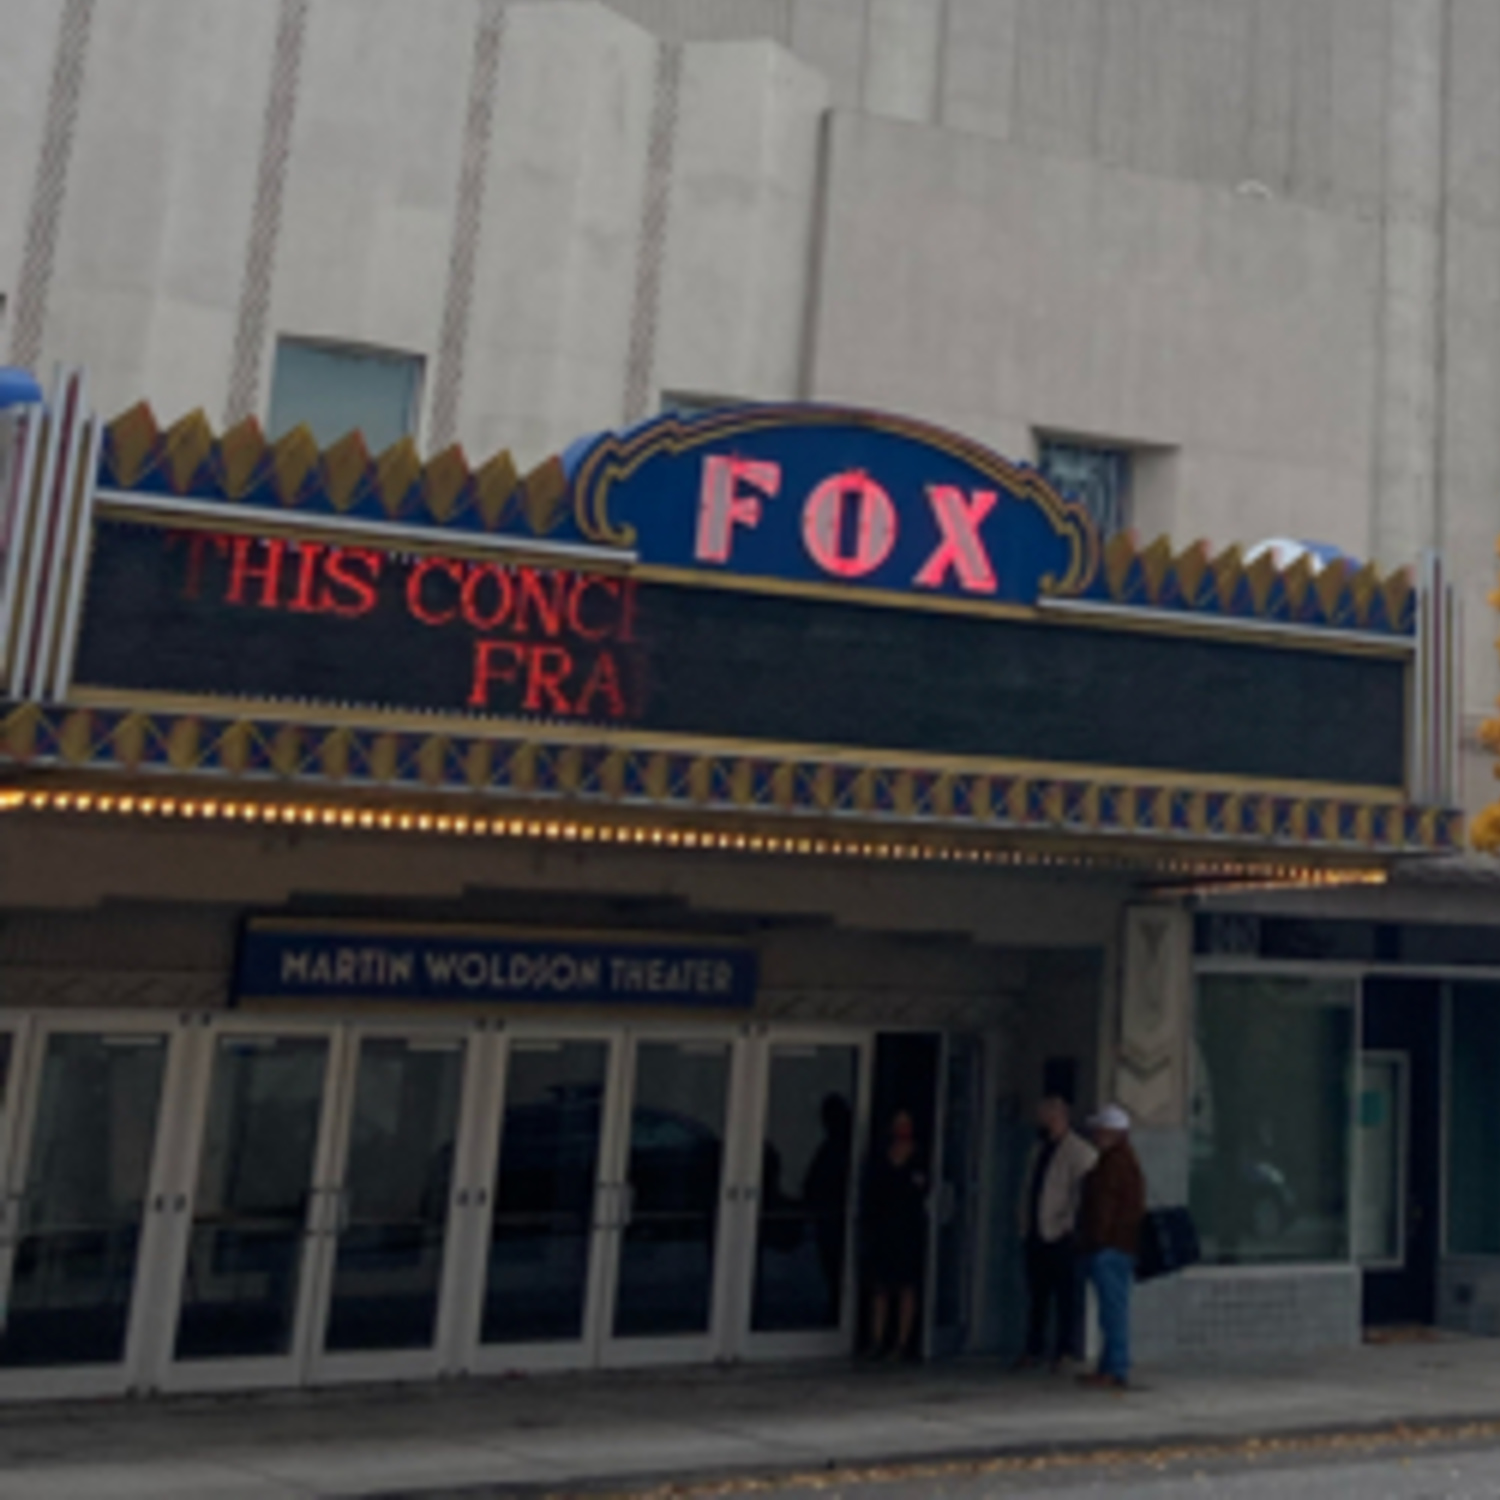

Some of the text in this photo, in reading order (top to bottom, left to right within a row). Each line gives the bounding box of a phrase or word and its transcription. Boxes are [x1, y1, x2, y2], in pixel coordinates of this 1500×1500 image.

[695, 452, 998, 592] FOX
[168, 530, 384, 619] THIS
[467, 637, 646, 719] FRA
[280, 946, 734, 994] MARTIN WOLDSON THEATER
